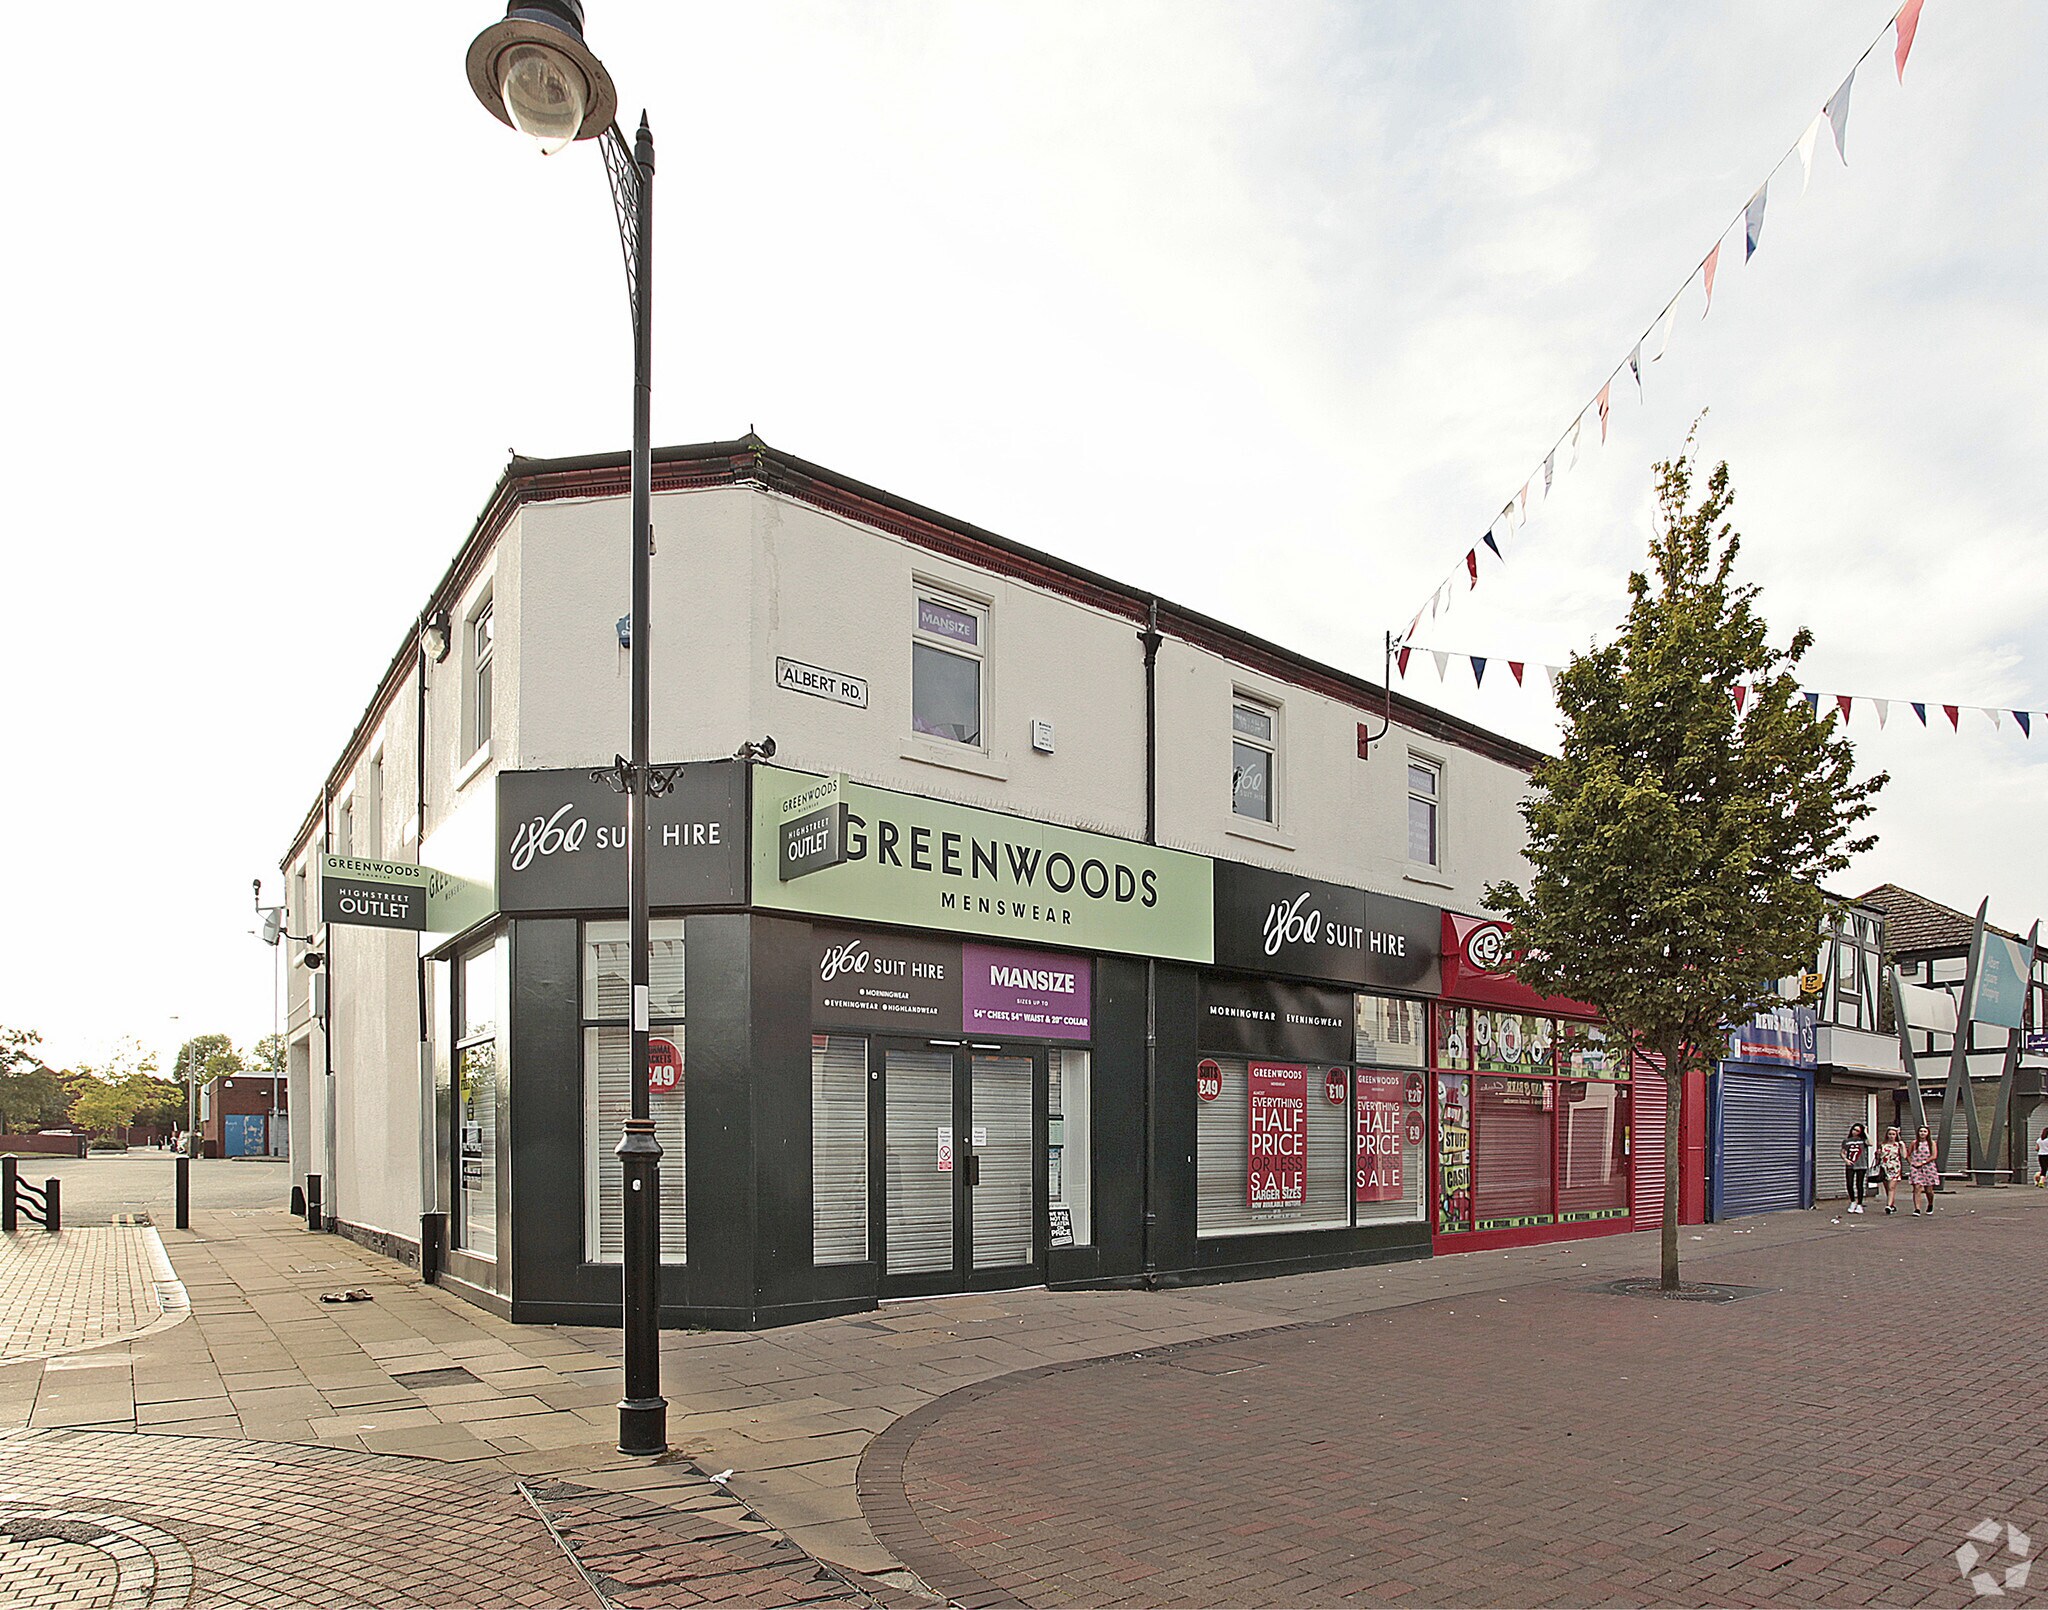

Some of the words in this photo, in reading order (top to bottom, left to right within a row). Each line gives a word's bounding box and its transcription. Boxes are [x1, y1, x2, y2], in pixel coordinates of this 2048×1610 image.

[921, 611, 971, 637] MANSIZE
[783, 667, 837, 693] ALBERT
[841, 682, 861, 701] RD.
[782, 779, 838, 813] GREENWOODS
[509, 802, 589, 871] 1860
[596, 825, 652, 849] SU
[662, 822, 722, 847] HIRE
[788, 817, 830, 840] HIGHSTREET
[788, 829, 829, 861] OUTLET
[328, 857, 420, 878] GREENWOODS
[846, 812, 1159, 908] GREENWOODS
[339, 888, 409, 903] HIGHSTREET
[339, 898, 409, 919] OUTLET
[941, 891, 1073, 925] MENSWEAR
[1263, 891, 1321, 956] 1860
[1326, 922, 1363, 949] SUIT
[1370, 930, 1406, 957] HIRE
[820, 939, 870, 981] 1860
[873, 958, 907, 976] SUIT
[911, 961, 945, 980] HIRE
[990, 965, 1075, 994] MANSIZE
[865, 988, 910, 999] MORNINGWEAR
[1016, 998, 1032, 1006] SIZES
[830, 999, 879, 1010] EVENINGWEAR
[887, 1004, 939, 1015] HIGHLANDWEAR
[1209, 1005, 1276, 1021] MORNINGWEAR
[1286, 1014, 1343, 1028] EVENINGWEAR
[1023, 1013, 1045, 1023] WAIST
[1045, 1015, 1051, 1024] &
[1063, 1017, 1088, 1027] COLLAR
[648, 1054, 672, 1064] ACKETS
[1200, 1066, 1218, 1078] SUITS
[1253, 1068, 1302, 1080] GREENWOODS
[1358, 1075, 1399, 1085] GREENWOODS
[1199, 1079, 1218, 1096] £49
[1329, 1083, 1344, 1100] £10
[1408, 1089, 1422, 1103] £20
[1252, 1096, 1303, 1109] EVERYTHING
[1357, 1101, 1400, 1112] EVERYTHING
[1251, 1107, 1304, 1132] HALF
[1357, 1111, 1400, 1134] HALF
[1409, 1126, 1420, 1140] £9
[1445, 1131, 1467, 1148] STUFF
[1251, 1133, 1303, 1156] PRICE
[1356, 1134, 1400, 1155] PRICE
[1251, 1156, 1271, 1171] OR
[1274, 1156, 1303, 1171] LESS
[1357, 1155, 1373, 1170] OR
[1377, 1155, 1400, 1170] LESS
[1250, 1171, 1303, 1191] SALE
[1356, 1169, 1400, 1188] SALE
[1447, 1167, 1469, 1189] CASH
[1251, 1189, 1280, 1201] LARGER
[1282, 1188, 1302, 1200] SIZES
[1051, 1229, 1072, 1237] PRICE
